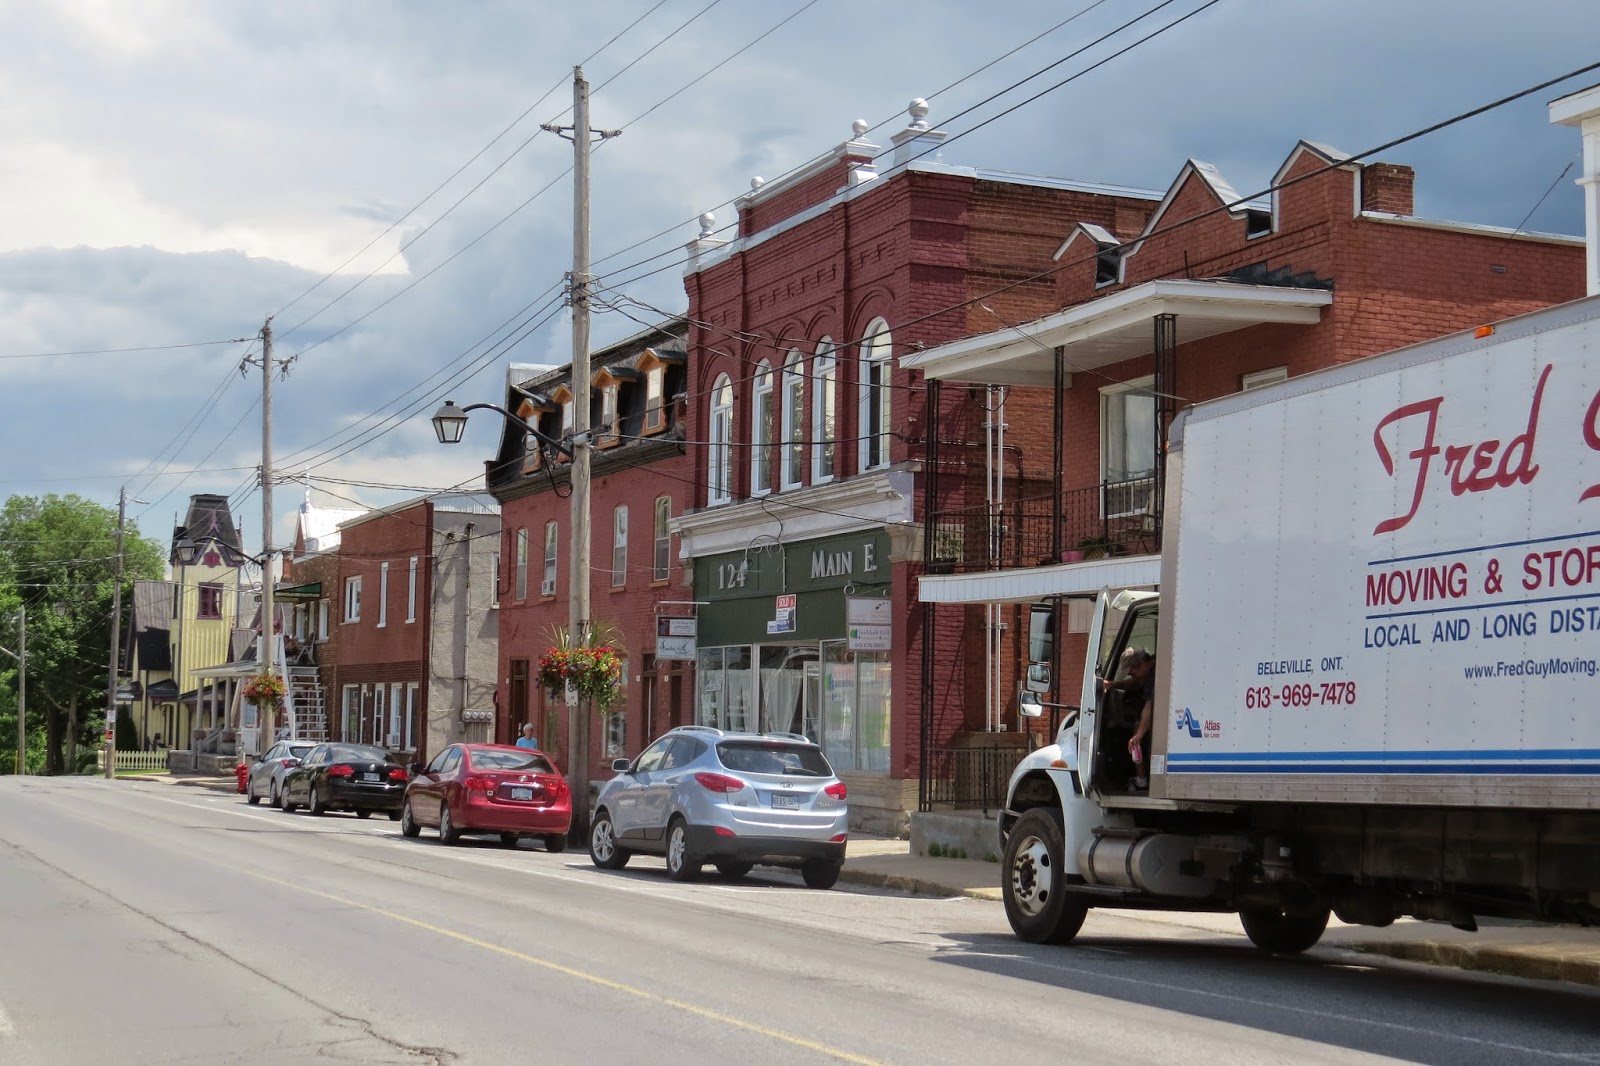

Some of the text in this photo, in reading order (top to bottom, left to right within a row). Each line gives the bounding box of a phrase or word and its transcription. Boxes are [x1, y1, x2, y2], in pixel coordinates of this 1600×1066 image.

[1373, 363, 1553, 536] Fred
[718, 562, 747, 590] 124
[1366, 562, 1468, 607] MOVING
[1484, 558, 1503, 595] &
[778, 597, 790, 607] SOLD
[1364, 606, 1600, 648] LOCAL AND LONG DIST
[1257, 657, 1344, 675] BELLEVILLE, ONT.
[1246, 681, 1356, 709] 613-969-7478
[1204, 720, 1221, 731] Atlas
